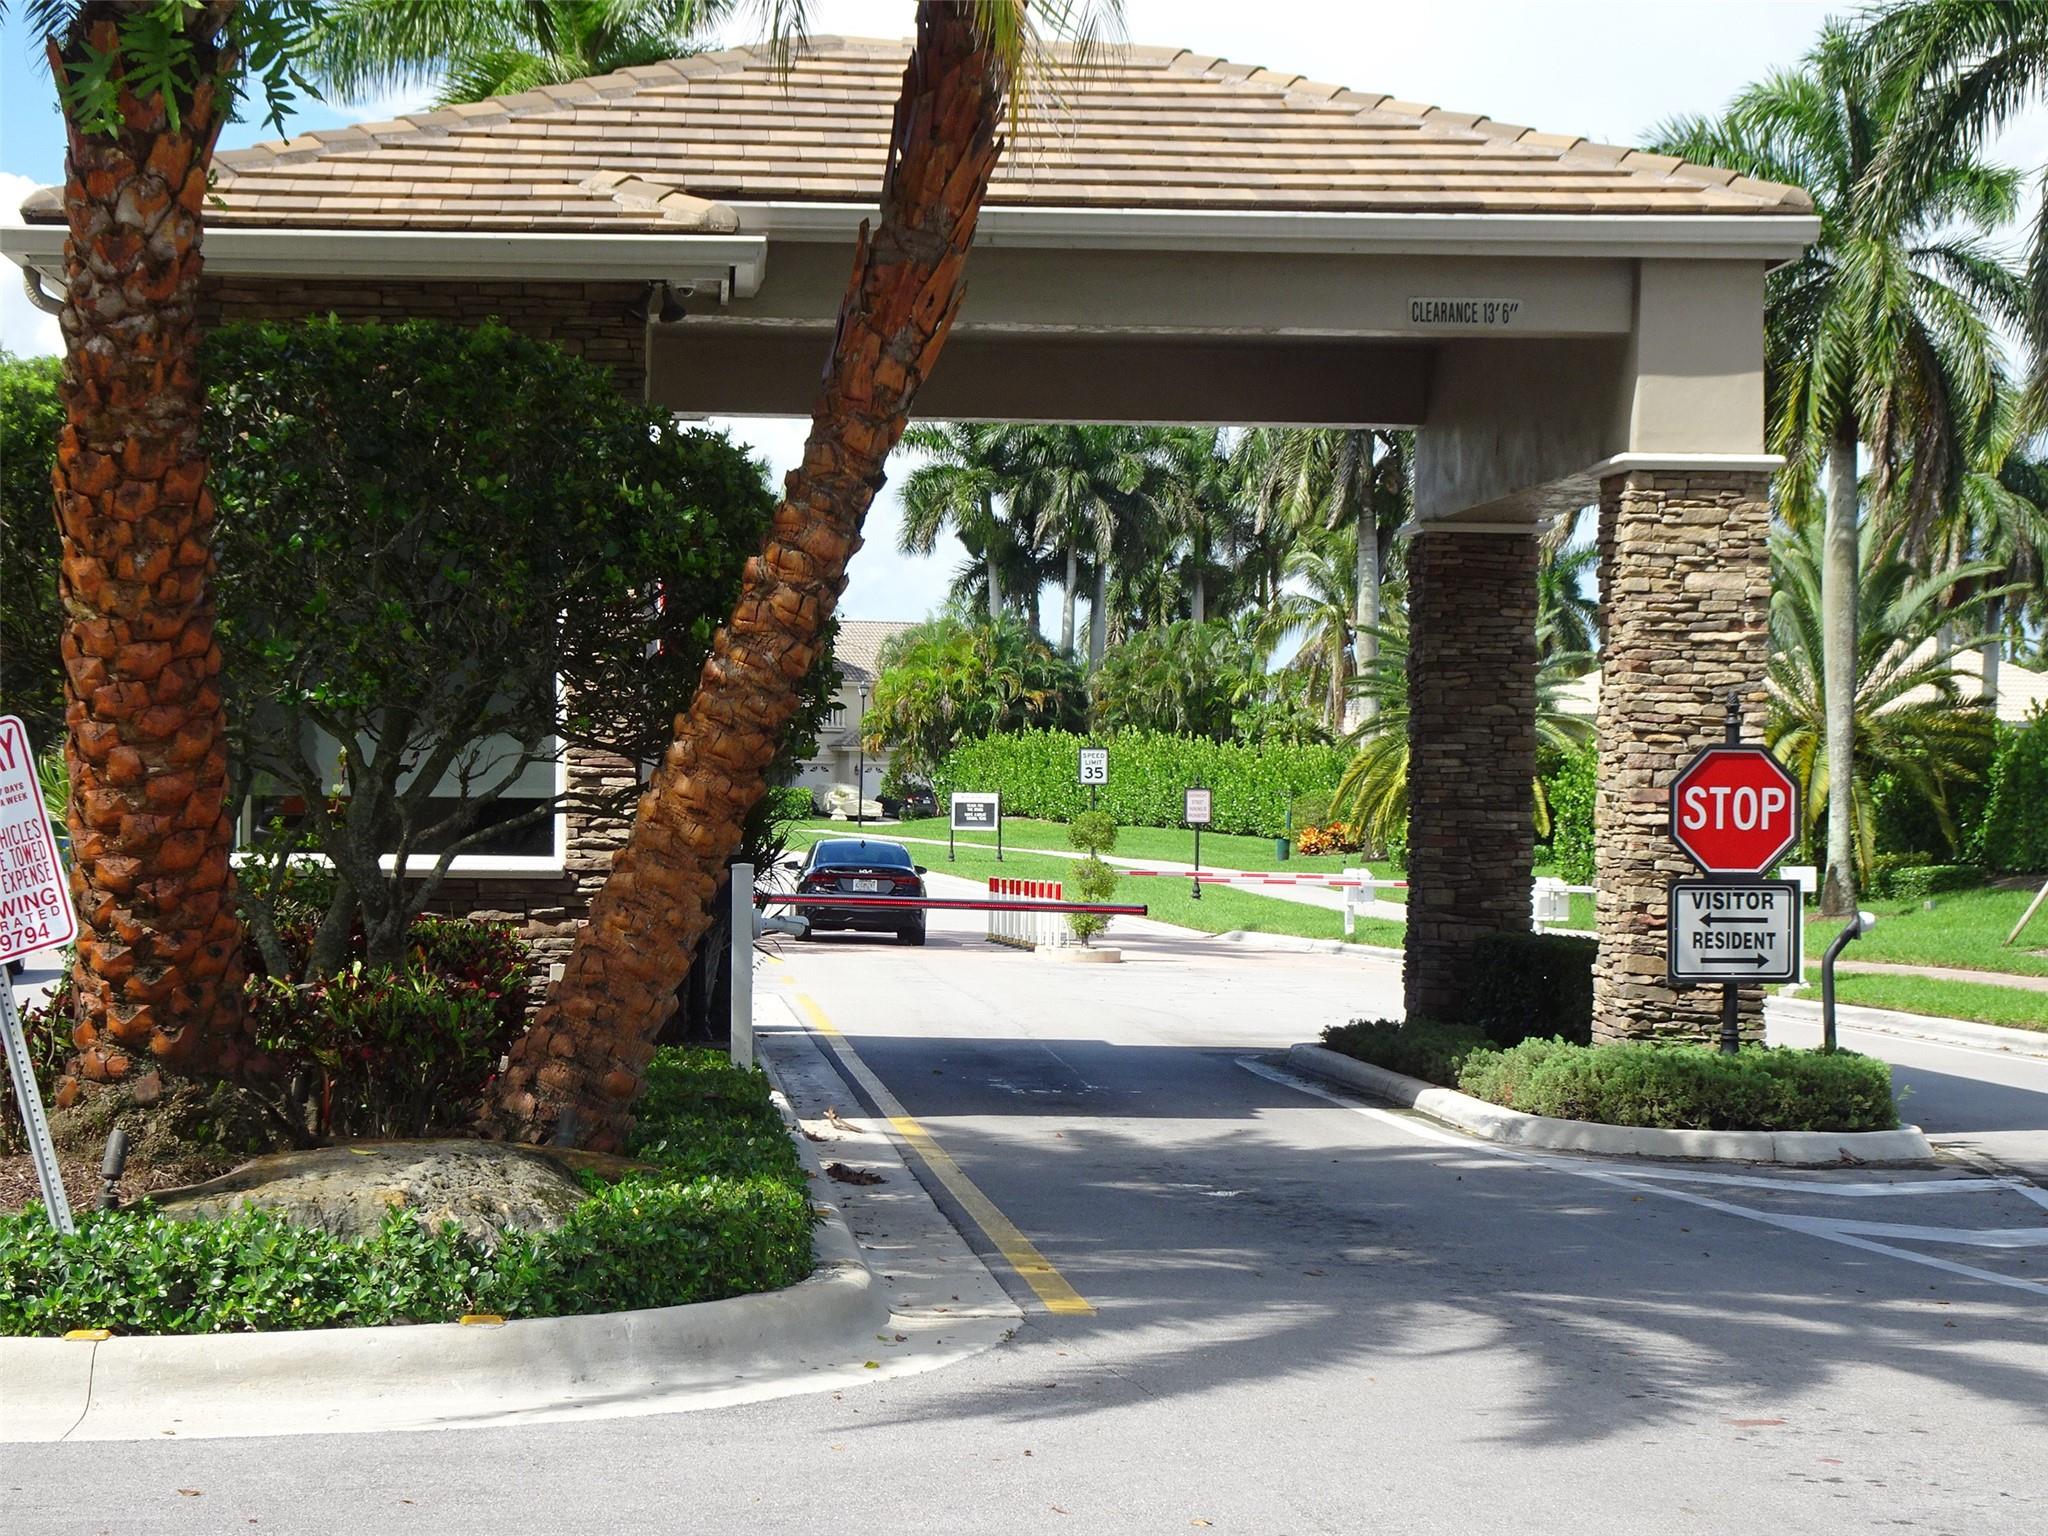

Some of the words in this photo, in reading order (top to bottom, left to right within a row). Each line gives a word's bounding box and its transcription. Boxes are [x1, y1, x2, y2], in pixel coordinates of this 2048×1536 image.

[1411, 301, 1479, 324] CLEARANCE
[1084, 766, 1104, 780] 35
[4, 781, 25, 795] DAYS
[6, 791, 29, 805] WEEK
[1682, 786, 1786, 831] STOP
[9, 840, 47, 869] TOWED
[1, 861, 54, 895] EXPENSE
[1692, 891, 1775, 911] VISITOR
[1692, 931, 1777, 951] RESIDENT
